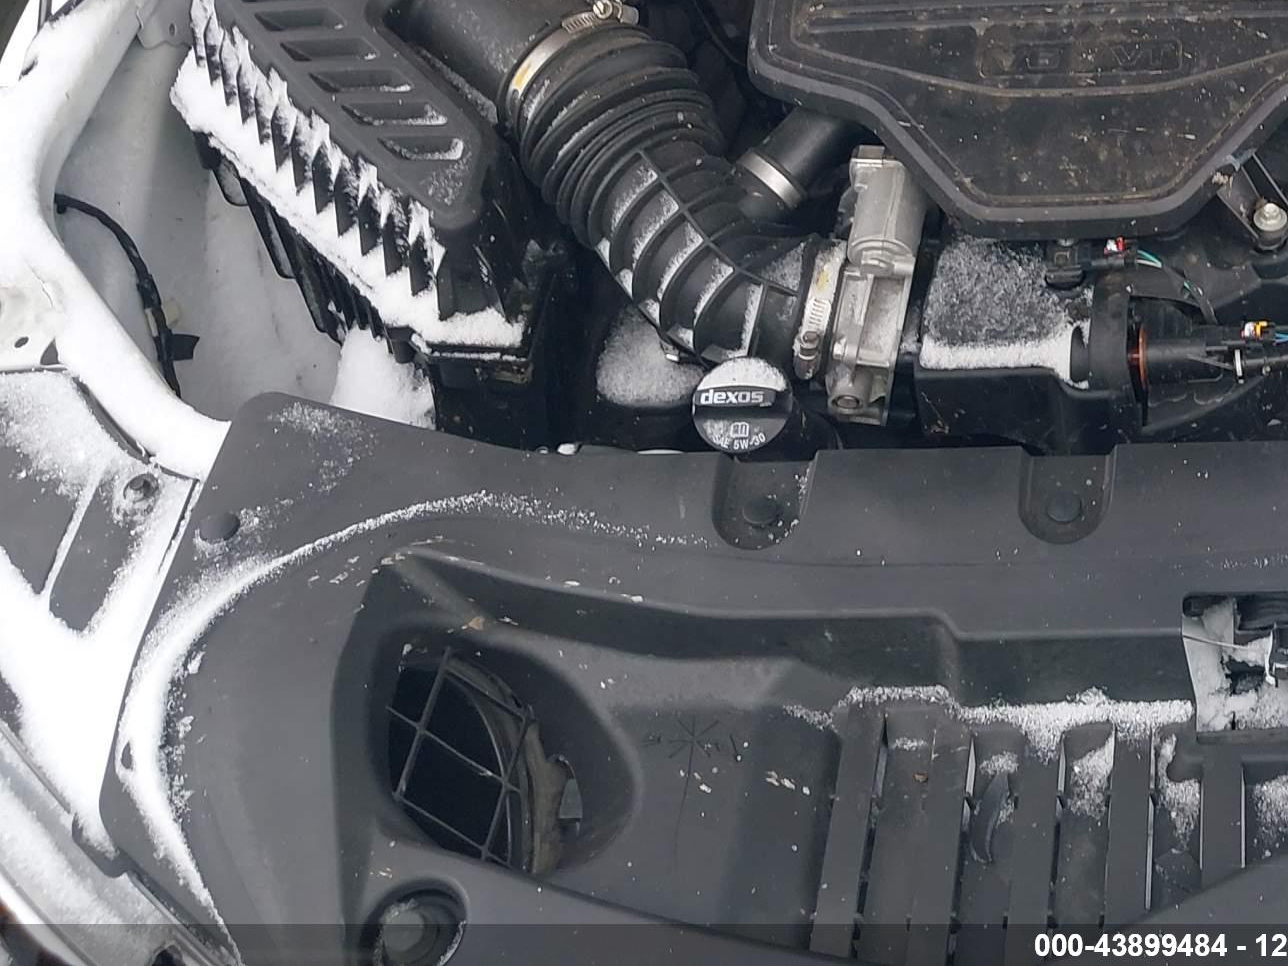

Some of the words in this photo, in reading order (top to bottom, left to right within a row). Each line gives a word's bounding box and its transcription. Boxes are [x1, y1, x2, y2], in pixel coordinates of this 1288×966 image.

[700, 389, 764, 405] dexos
[712, 435, 730, 450] SAE
[733, 432, 766, 450] 5W-30
